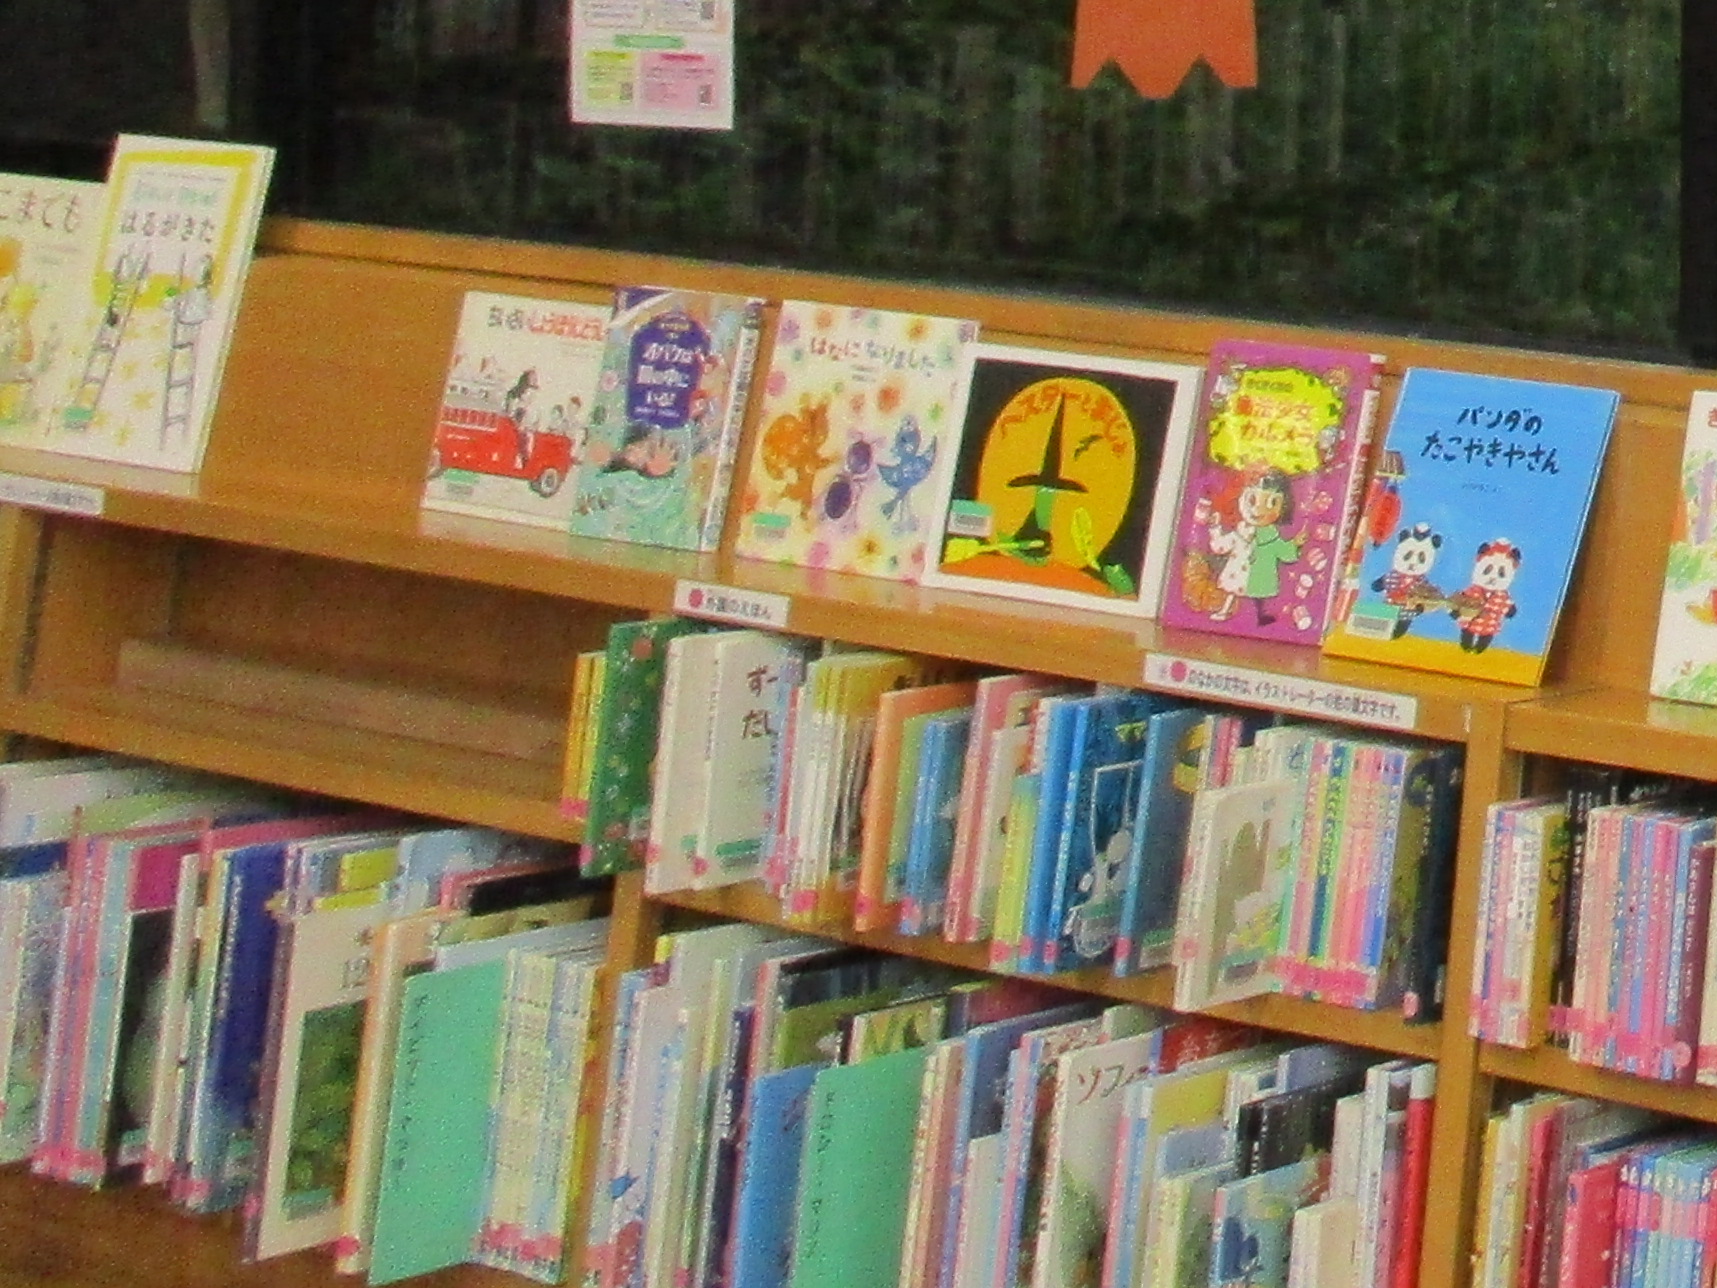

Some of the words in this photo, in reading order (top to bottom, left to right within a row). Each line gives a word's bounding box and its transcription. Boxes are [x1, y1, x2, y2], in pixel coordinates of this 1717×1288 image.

[1456, 403, 1543, 433] パンダの
[1421, 432, 1561, 475] たこやきやさん
